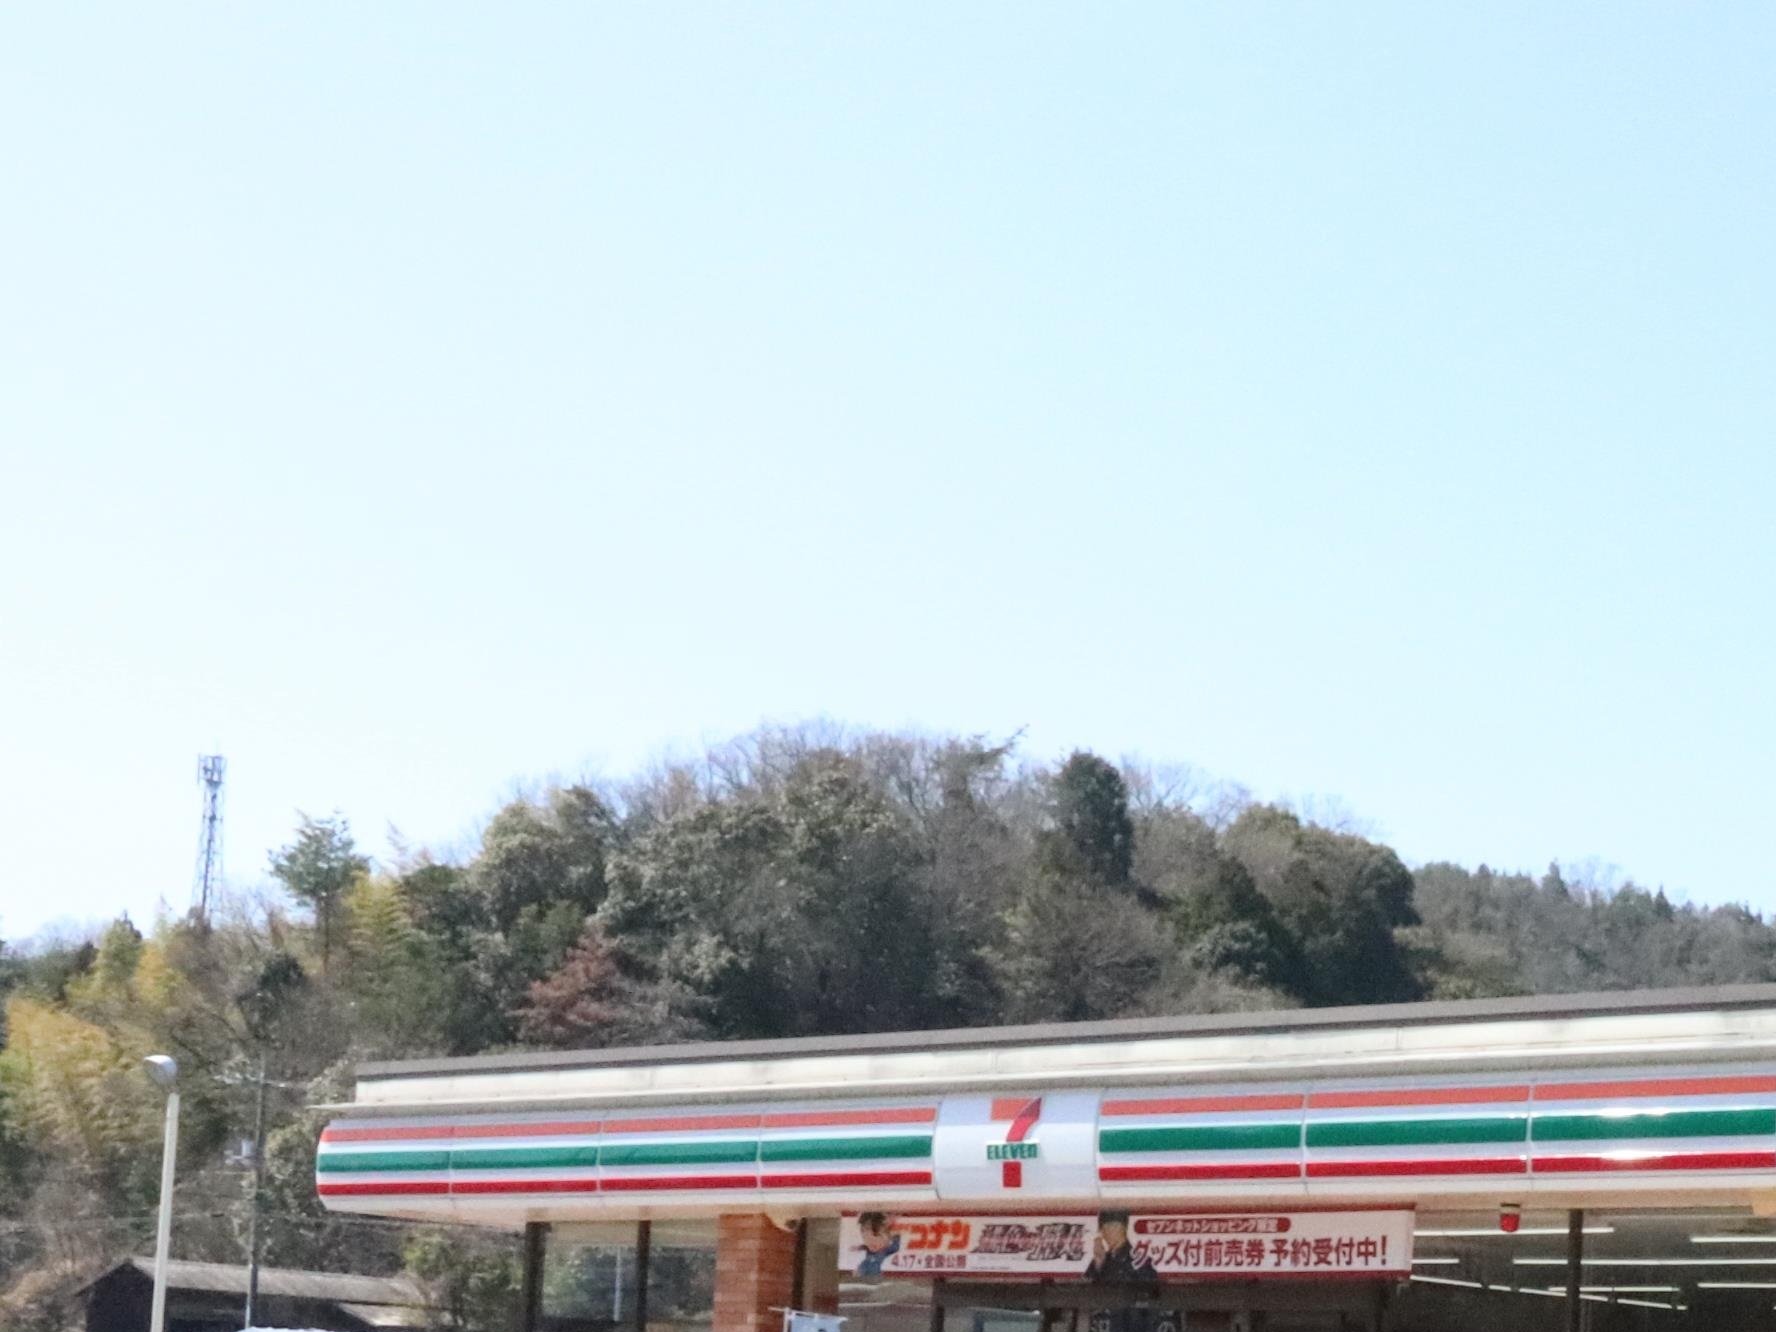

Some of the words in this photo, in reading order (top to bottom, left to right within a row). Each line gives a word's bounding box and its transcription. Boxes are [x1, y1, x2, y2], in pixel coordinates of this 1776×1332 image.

[1131, 1238, 1265, 1267] グッズ付前売券
